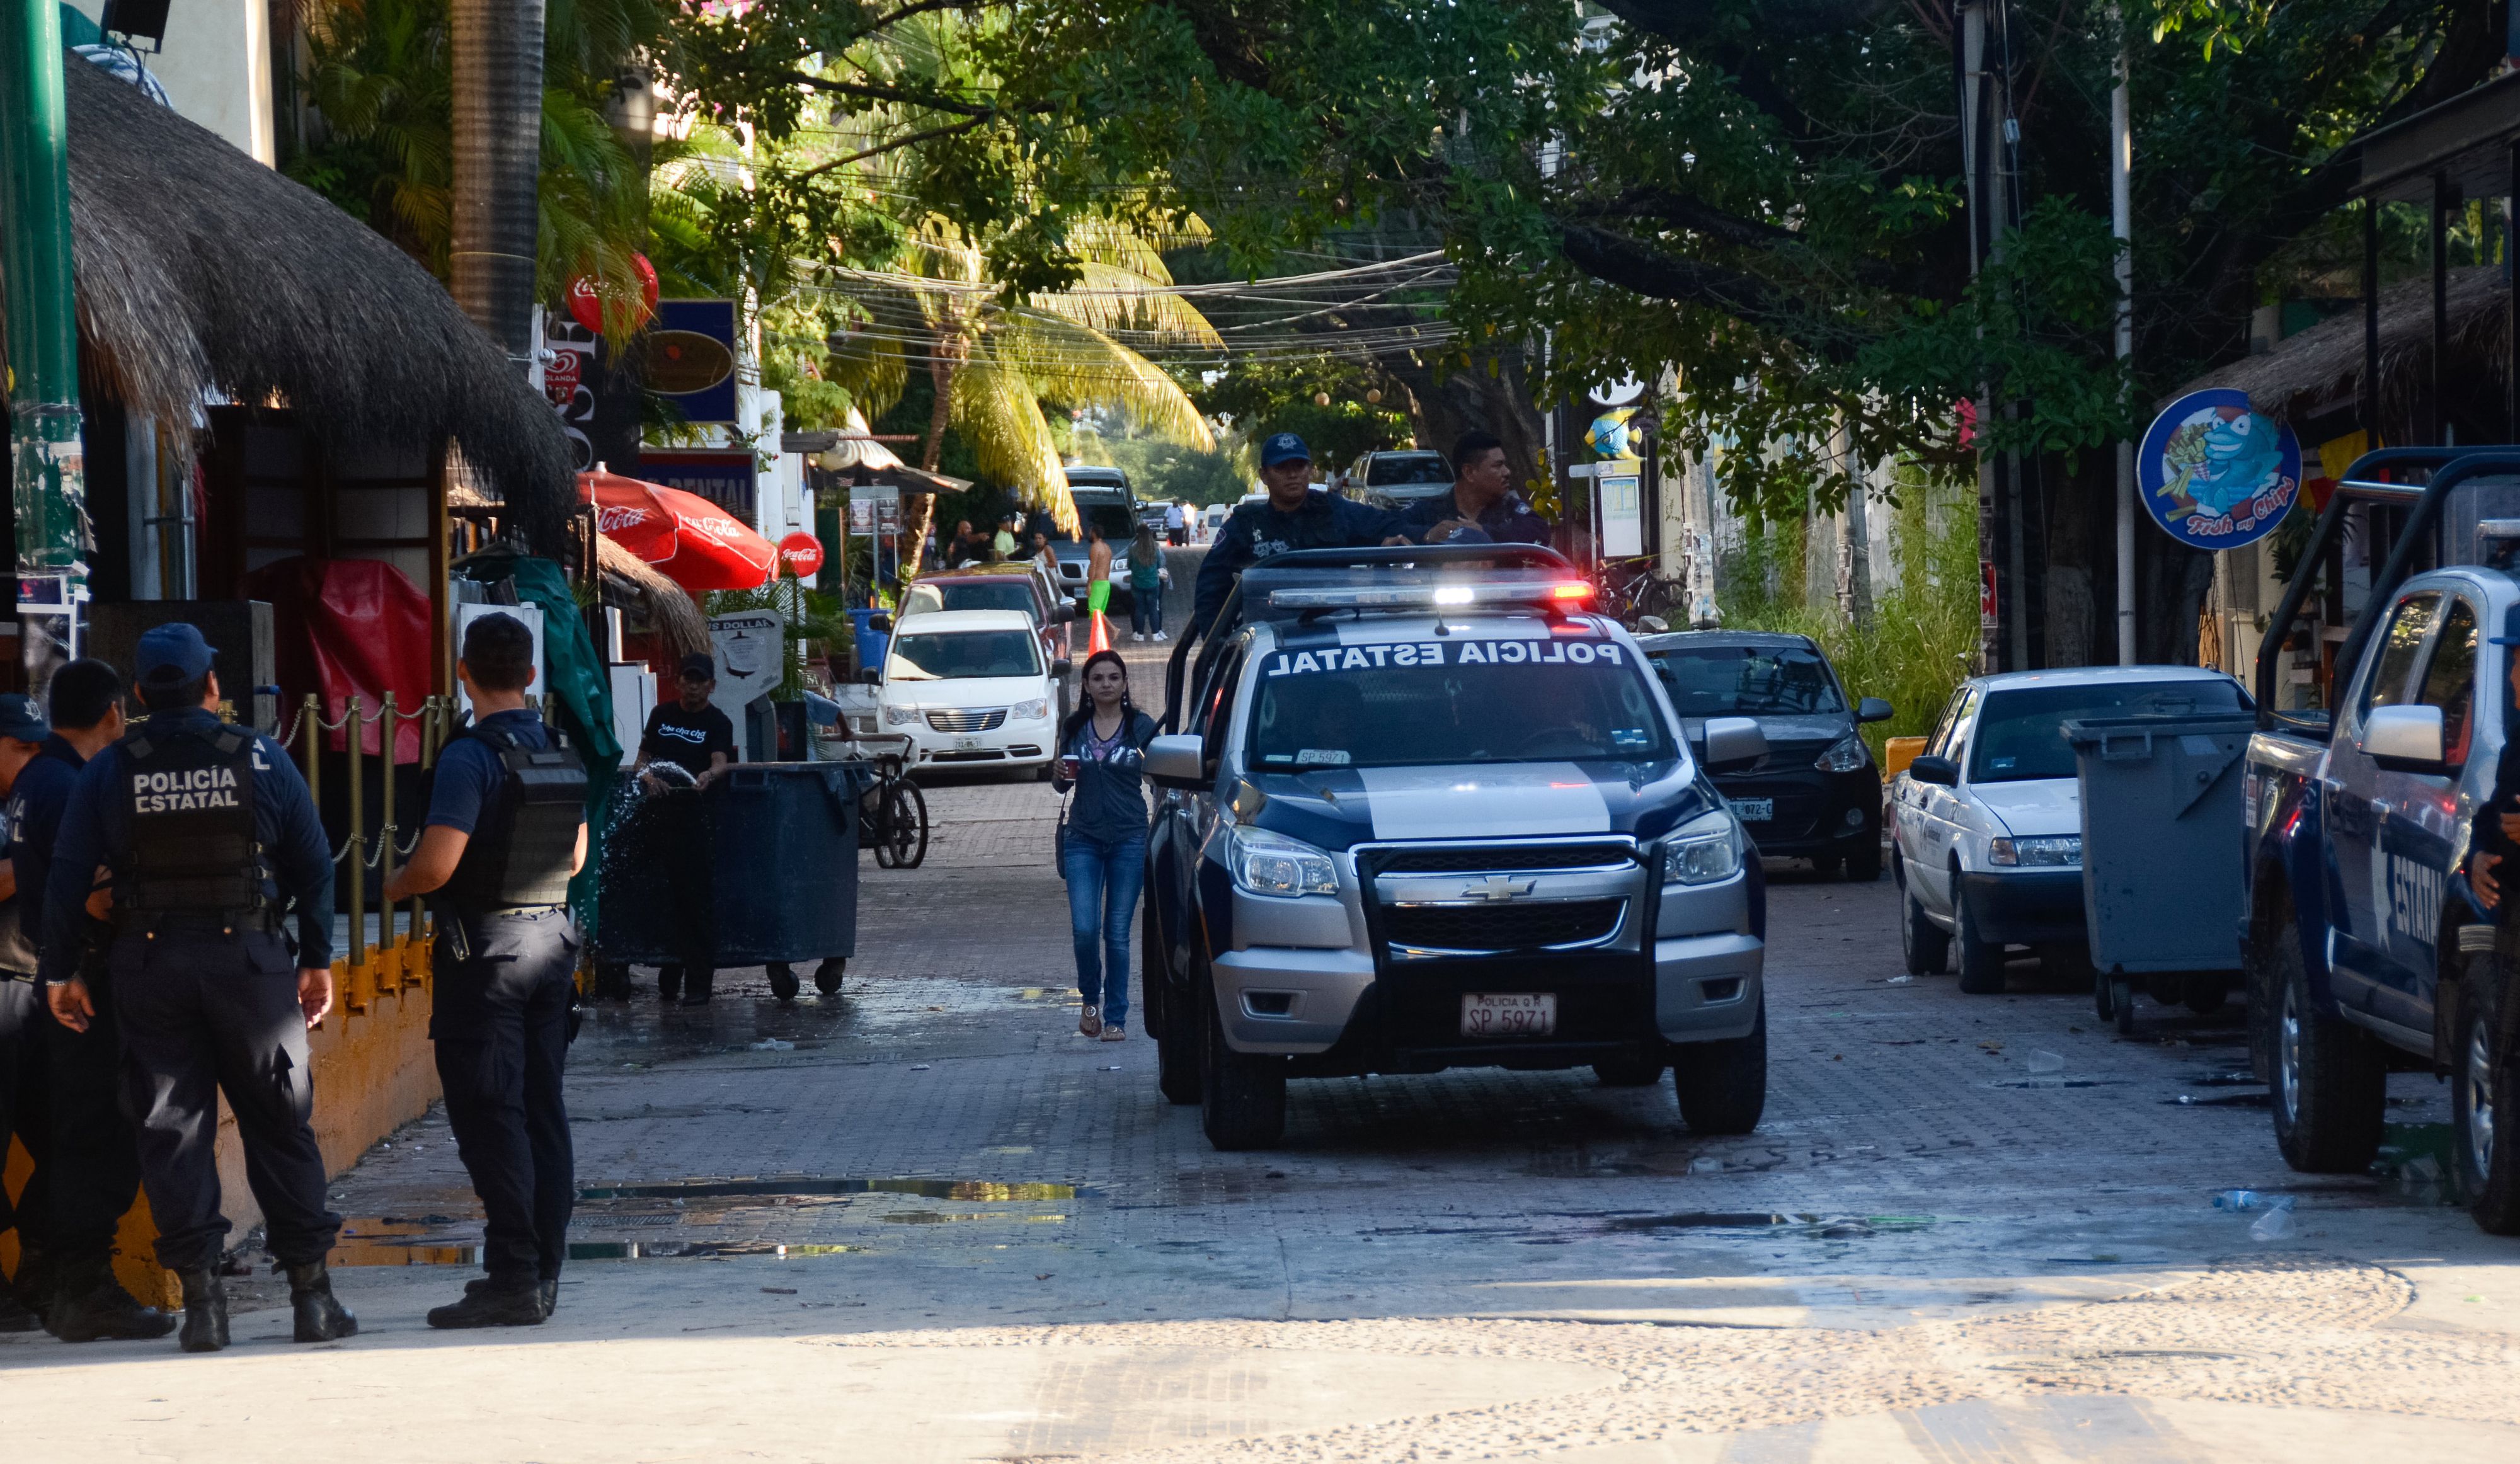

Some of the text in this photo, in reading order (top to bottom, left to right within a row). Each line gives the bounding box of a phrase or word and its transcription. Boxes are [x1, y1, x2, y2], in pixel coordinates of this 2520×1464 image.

[544, 374, 577, 382] OLANDA
[2187, 476, 2294, 535] Fish my Chips
[675, 727, 690, 735] cha
[690, 729, 706, 739] cha
[1301, 752, 1346, 763] SP 5971
[133, 765, 238, 794] POLICÍA
[135, 790, 239, 814] ESTATAL
[1477, 997, 1518, 1007] POLICIA
[1469, 1009, 1547, 1033] SP 5971
